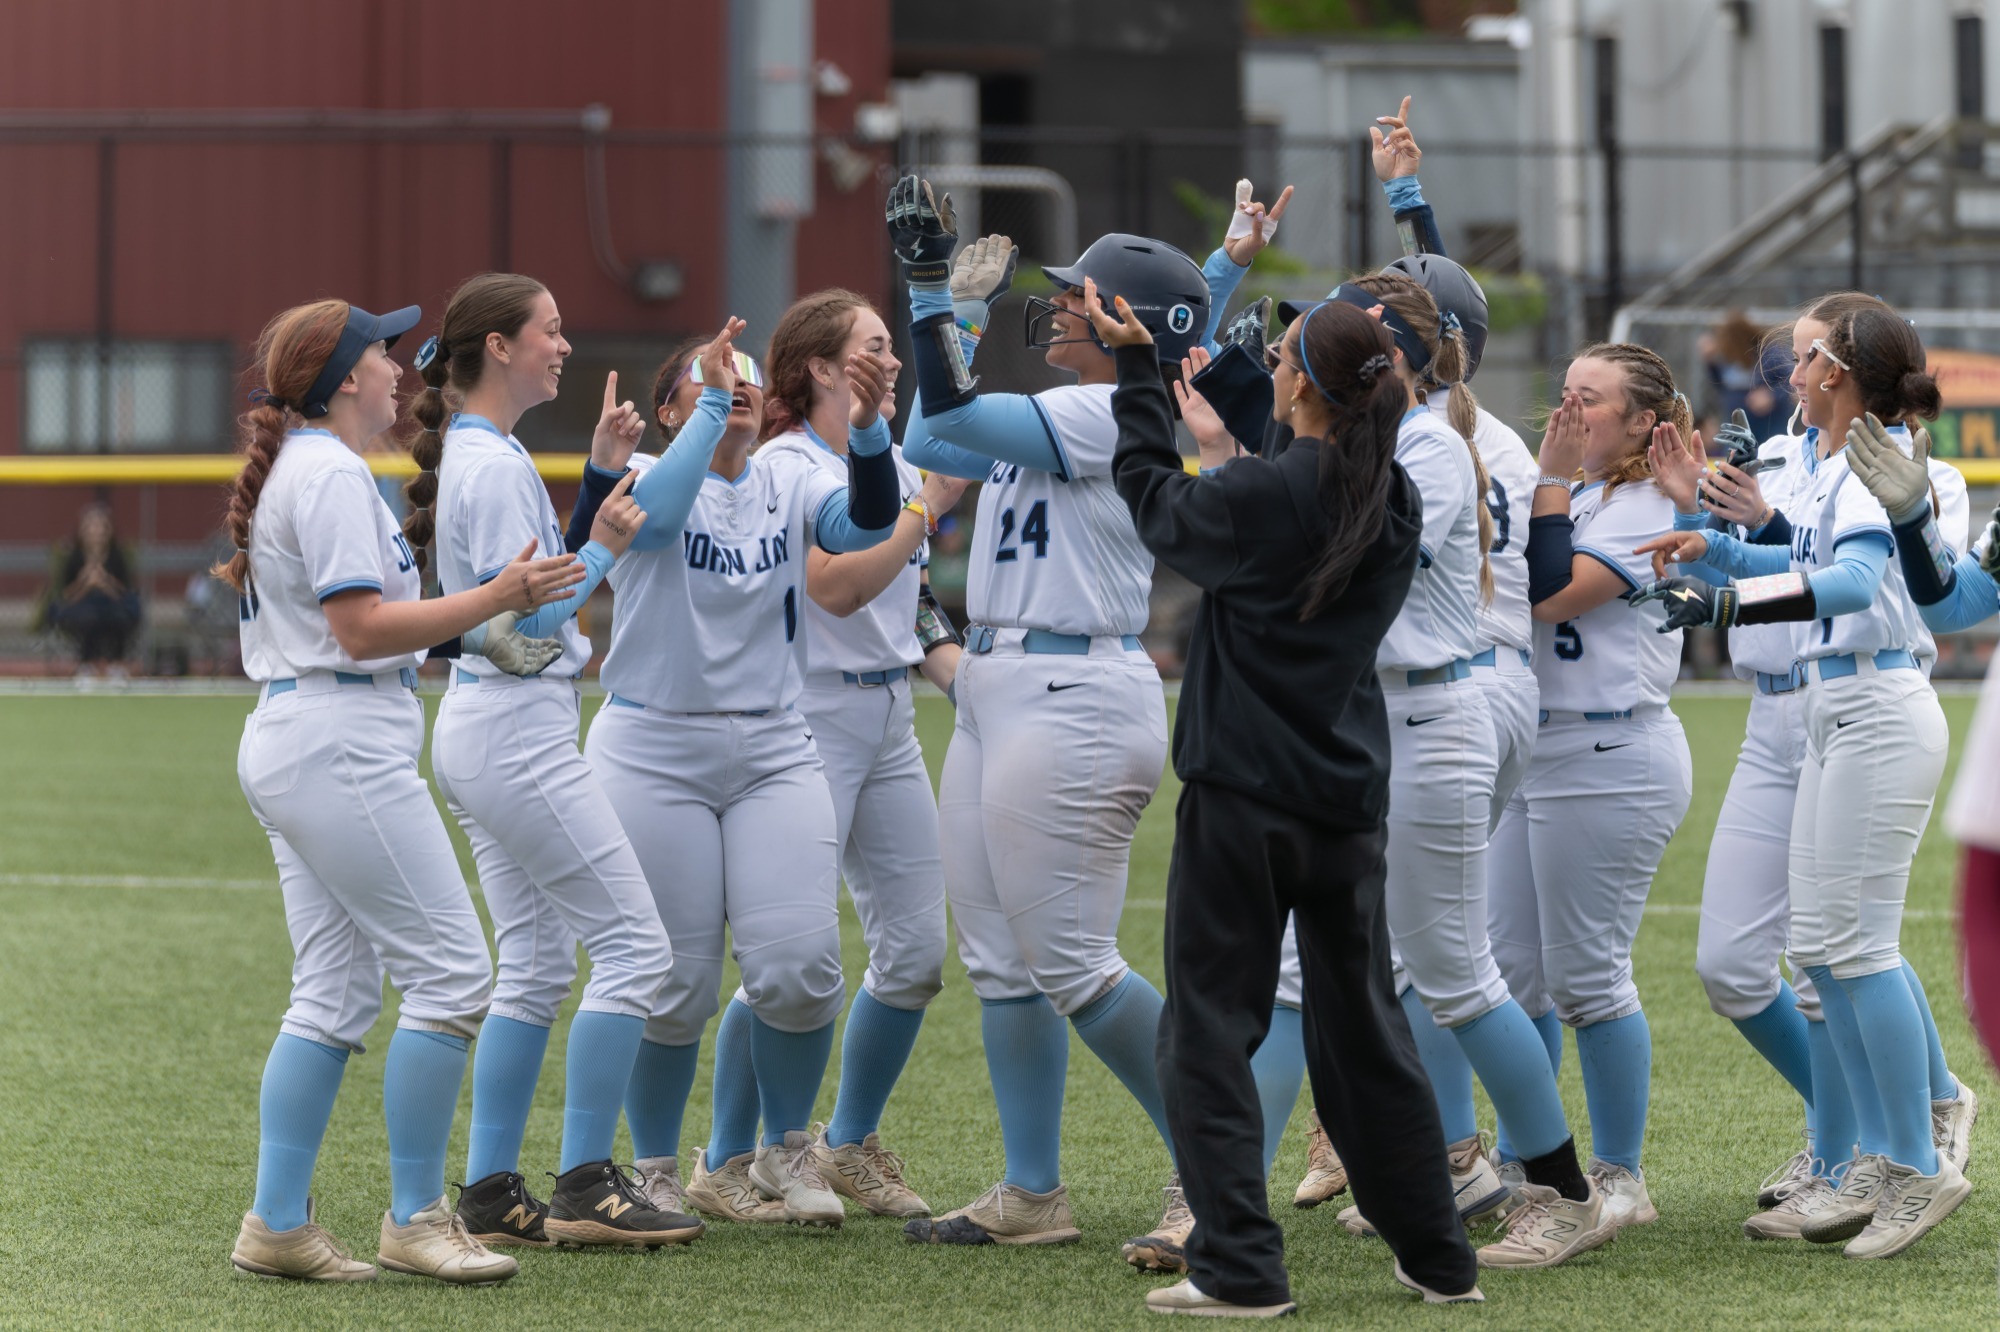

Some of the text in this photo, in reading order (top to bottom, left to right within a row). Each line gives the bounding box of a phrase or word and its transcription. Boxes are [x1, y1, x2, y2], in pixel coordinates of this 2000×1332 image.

[995, 499, 1051, 563] 24
[783, 584, 798, 644] 1
[1553, 617, 1584, 662] 5
